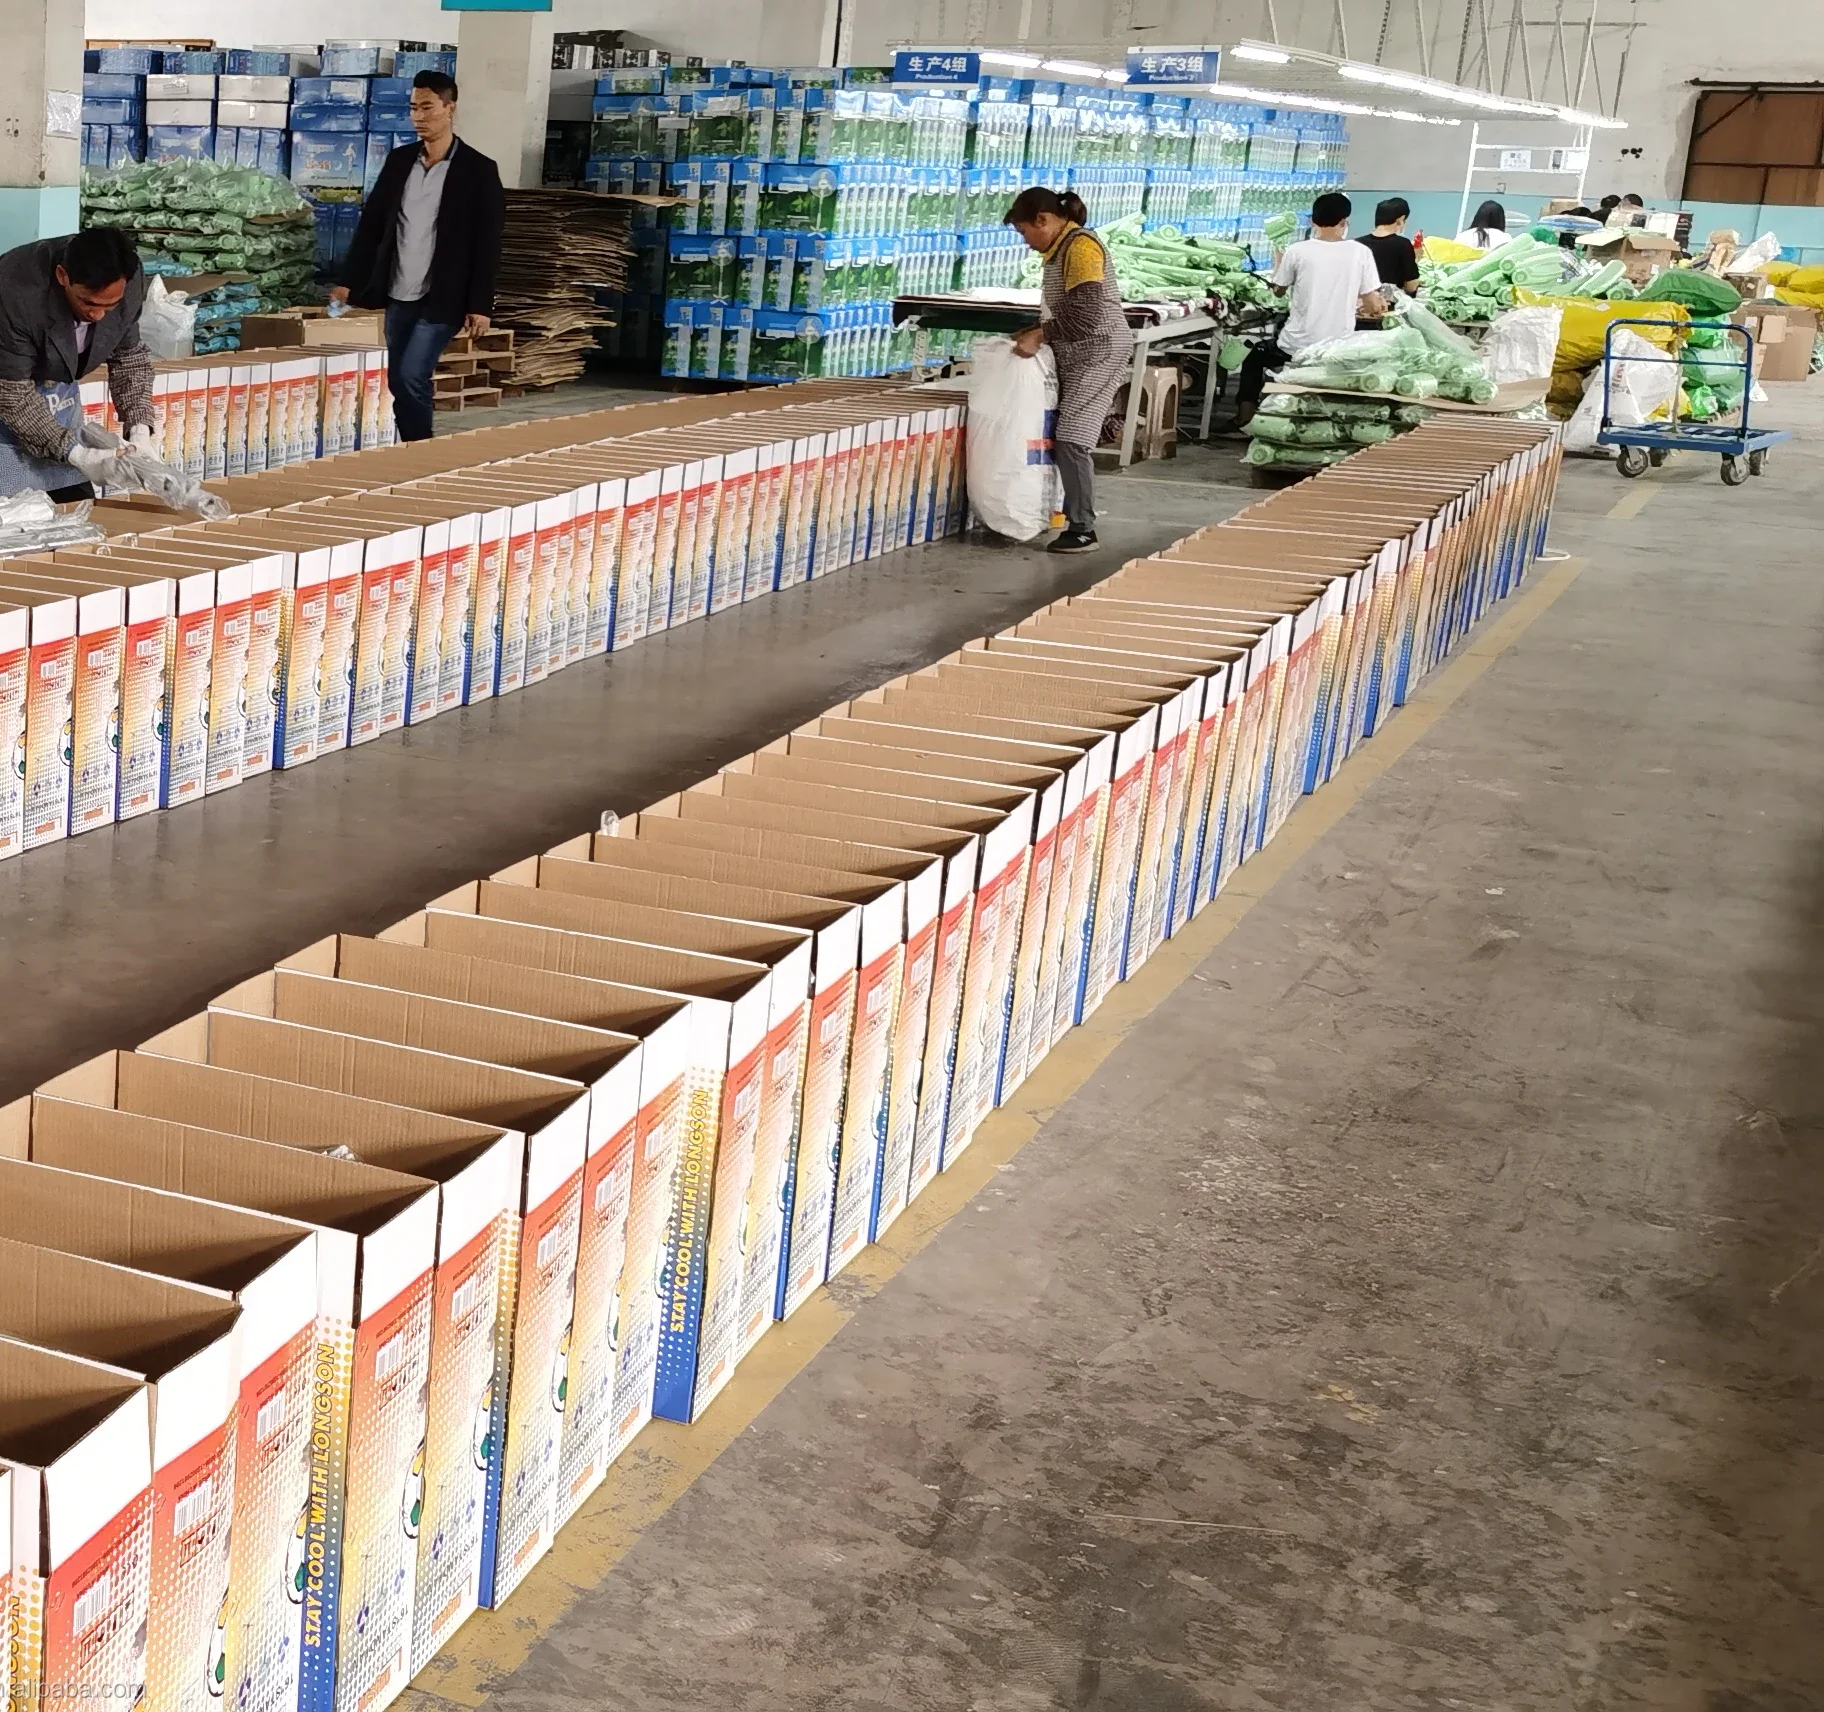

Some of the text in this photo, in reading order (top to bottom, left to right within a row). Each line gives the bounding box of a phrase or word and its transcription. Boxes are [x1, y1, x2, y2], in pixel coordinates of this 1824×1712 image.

[907, 55, 967, 74] 生产4组
[1140, 56, 1205, 74] 生产3组
[670, 1089, 709, 1334] STAY COOL WITH LONGSON
[304, 1343, 335, 1648] STAY COOL WITH LONGSON
